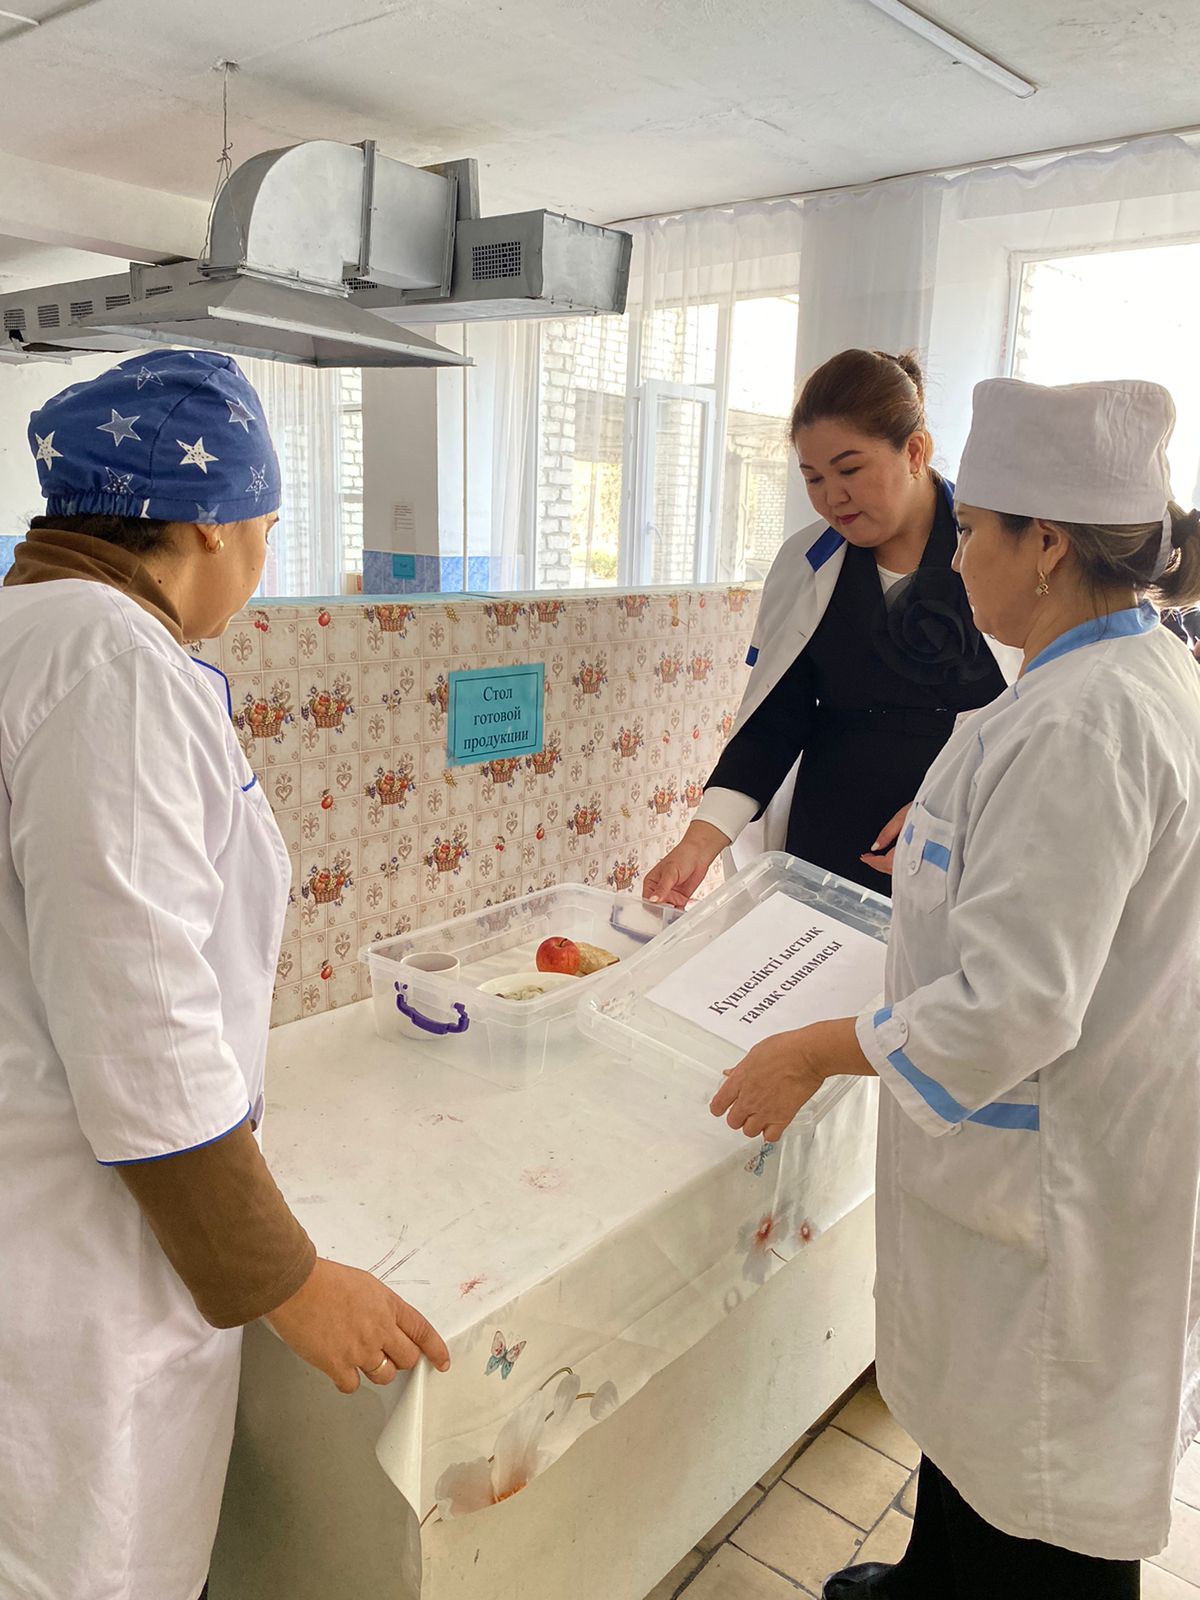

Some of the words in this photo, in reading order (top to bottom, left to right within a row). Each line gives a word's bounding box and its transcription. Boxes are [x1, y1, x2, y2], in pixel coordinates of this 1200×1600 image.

[483, 686, 513, 702] Стол
[473, 706, 521, 726] готовой
[463, 730, 529, 752] продукции
[780, 940, 843, 991] сынамасы
[708, 957, 783, 1015] Күнделікті
